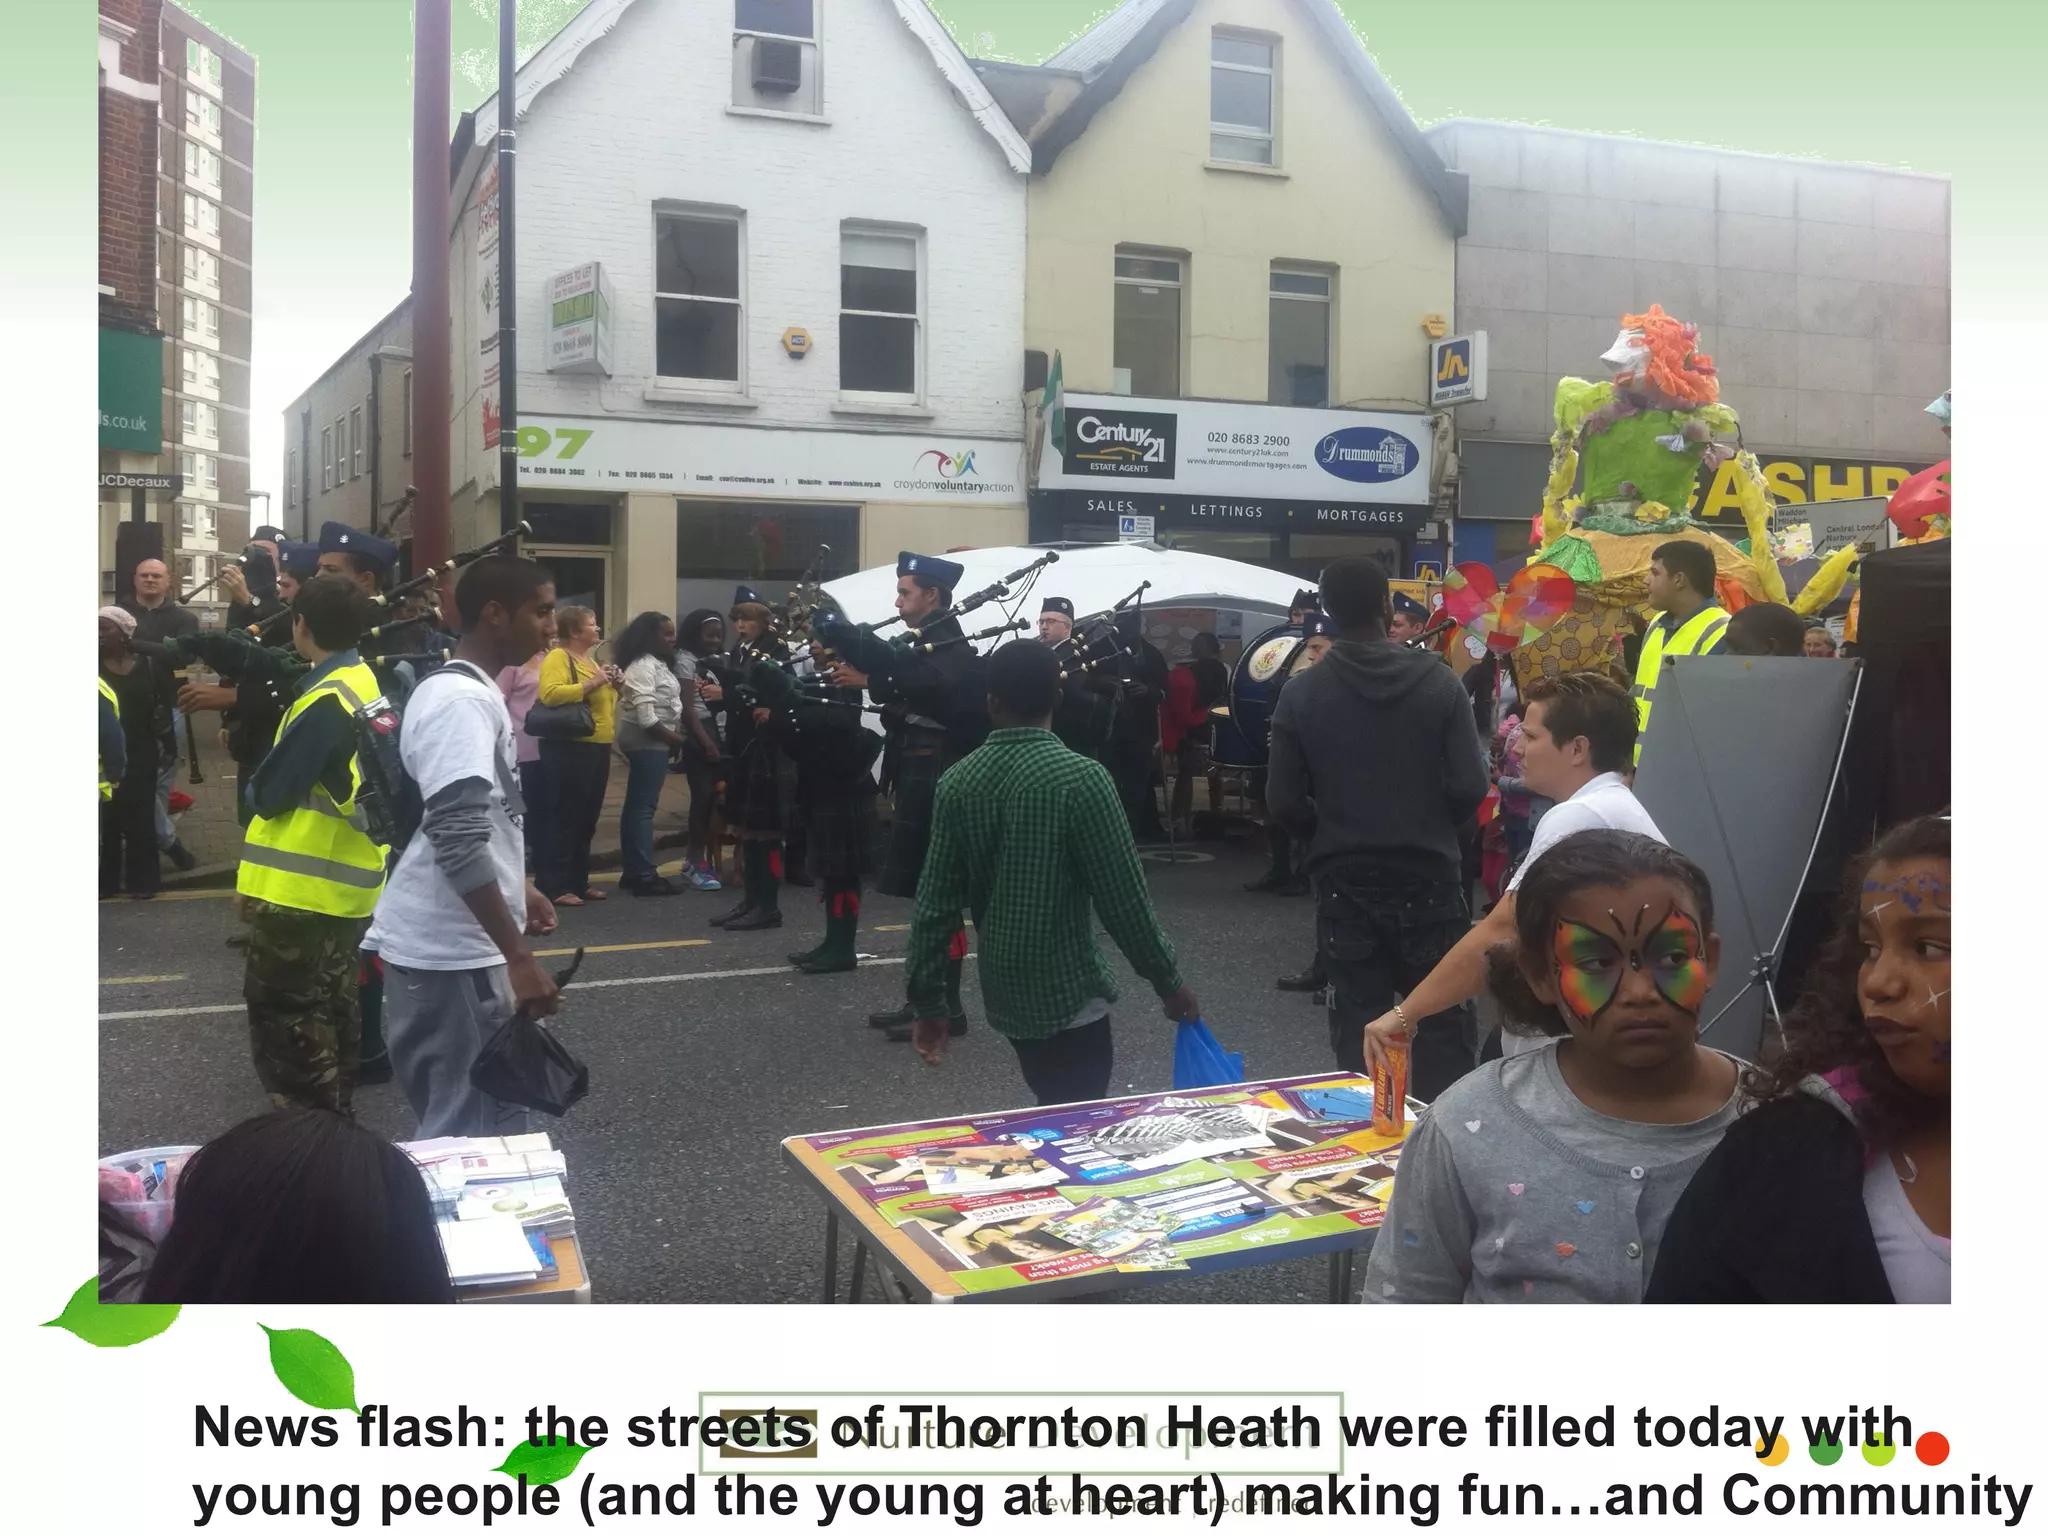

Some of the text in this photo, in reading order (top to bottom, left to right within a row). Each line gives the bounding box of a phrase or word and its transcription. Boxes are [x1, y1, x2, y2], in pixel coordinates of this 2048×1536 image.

[517, 426, 594, 459] 97
[1077, 416, 1165, 463] Century 21
[1207, 432, 1290, 446] 020 8683 2900
[1207, 447, 1289, 457] www.century21uk.com
[1322, 435, 1395, 463] Drummonds
[1090, 463, 1148, 472] ESTATE AGENTS
[1187, 458, 1307, 470] www.drummondsmortgages.com
[1087, 500, 1404, 523] SALES LETTINGS MORTGAGES
[1826, 524, 1885, 534] Central London
[972, 1202, 1036, 1218] SAVINGS
[1028, 1268, 1059, 1278] than
